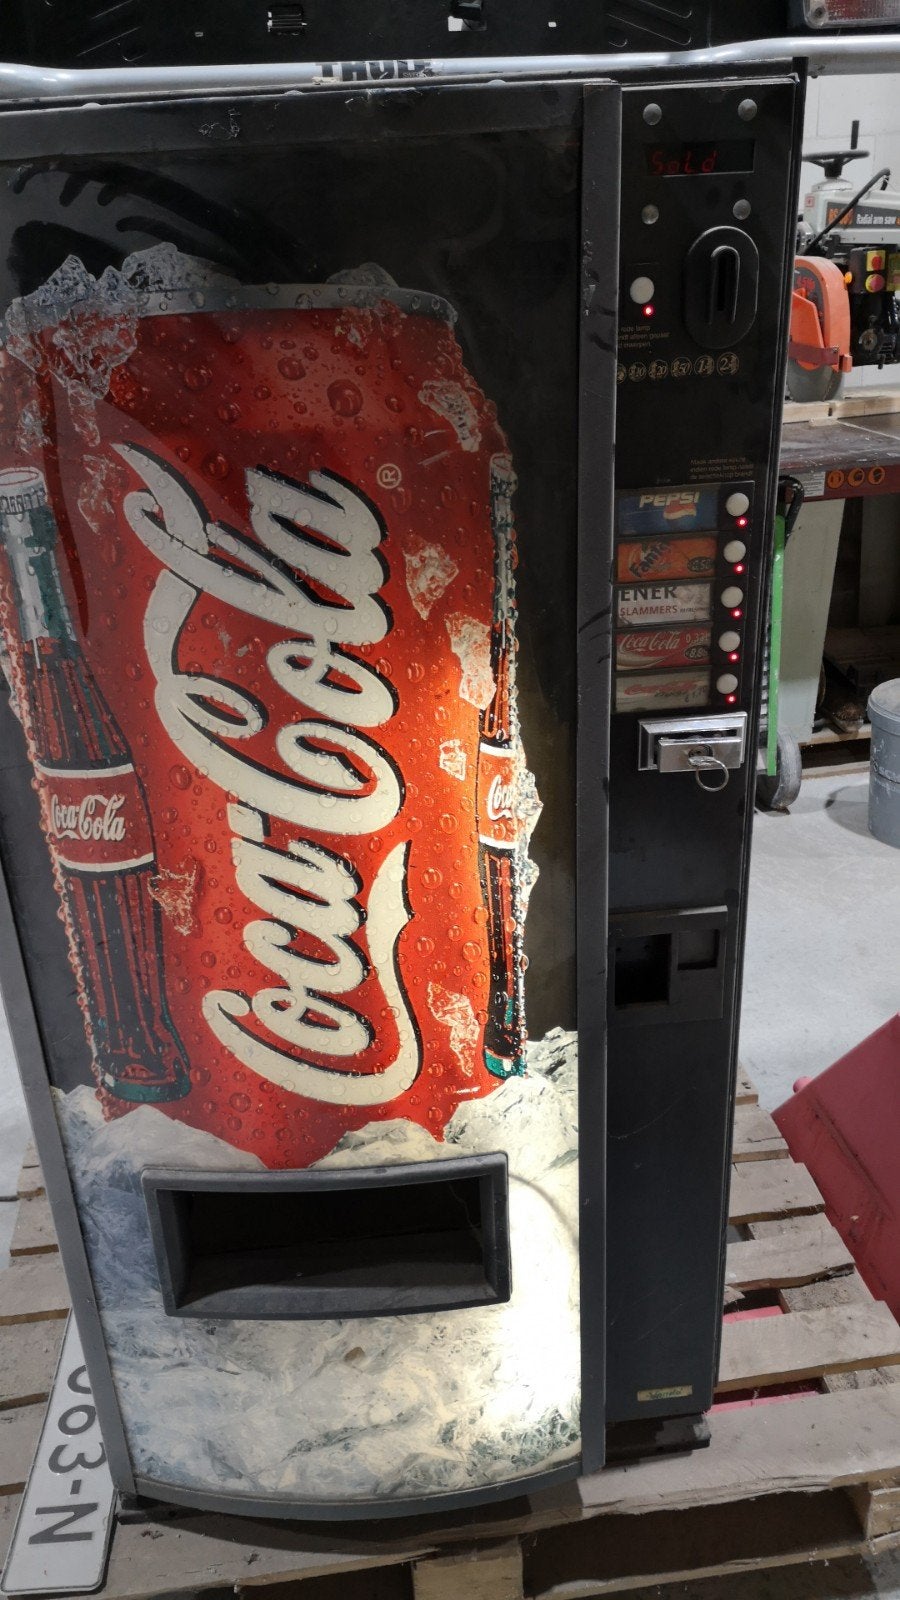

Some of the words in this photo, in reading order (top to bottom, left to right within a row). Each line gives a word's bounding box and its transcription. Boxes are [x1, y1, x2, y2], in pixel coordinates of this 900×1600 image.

[856, 213, 873, 225] Radial
[873, 216, 884, 225] arm
[884, 216, 896, 225] saw
[638, 491, 701, 509] PEPSI
[620, 605, 678, 616] SLAMMERS
[113, 441, 421, 1107] Coca-Cola
[51, 793, 126, 841] Coca-Cola
